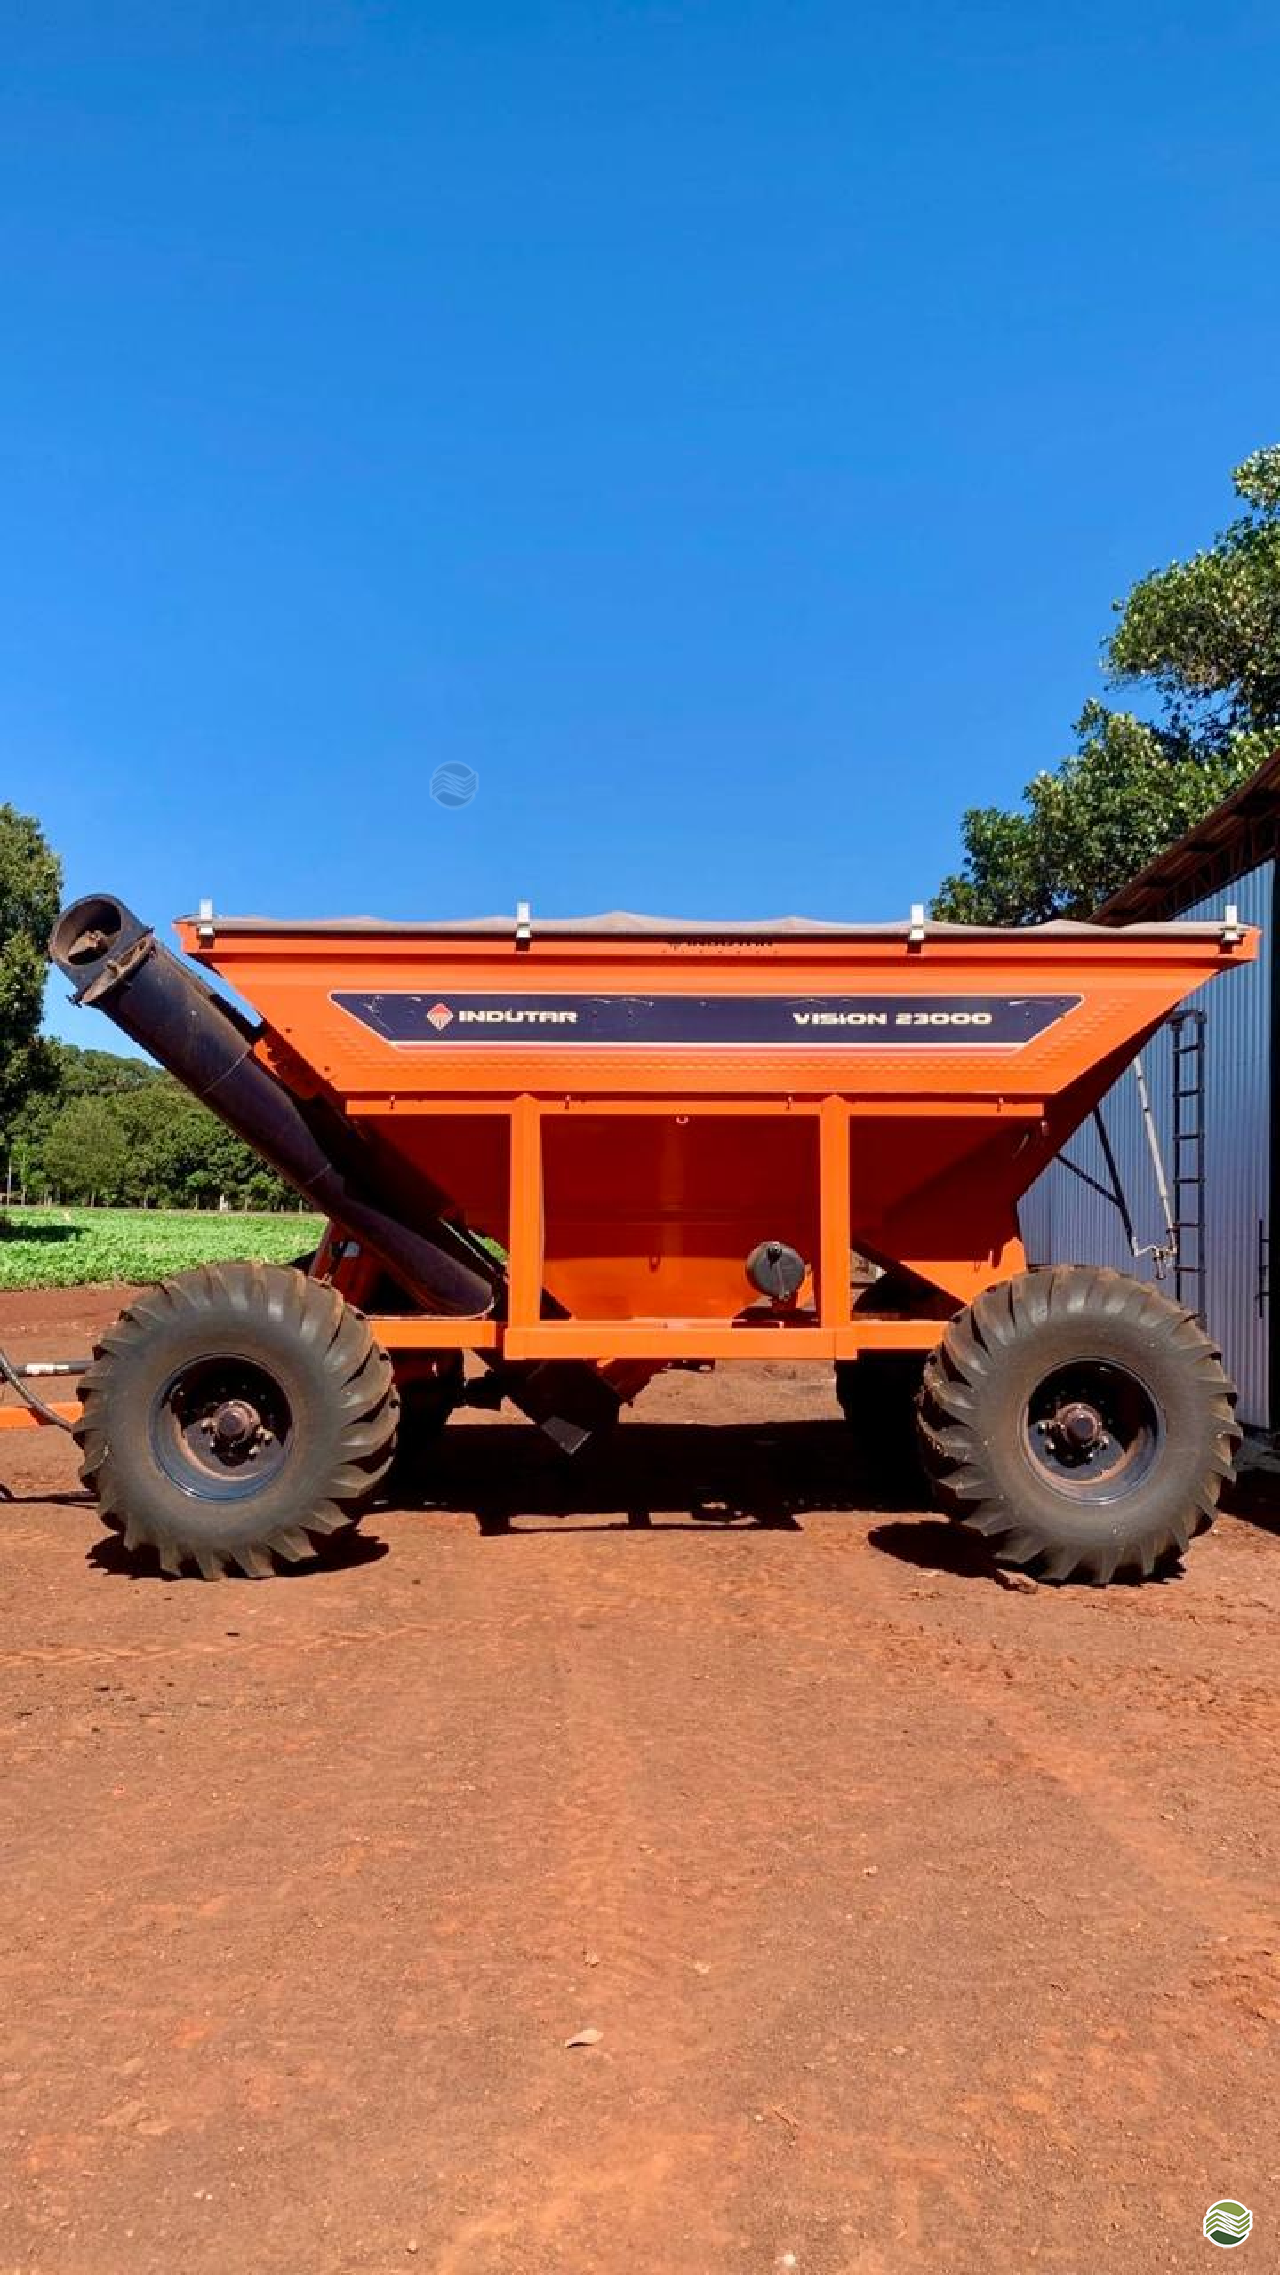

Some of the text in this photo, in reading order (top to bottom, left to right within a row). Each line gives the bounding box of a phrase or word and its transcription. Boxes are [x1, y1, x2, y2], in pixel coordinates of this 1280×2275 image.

[458, 1010, 578, 1023] INDUTAR
[793, 1012, 993, 1025] VISION 23000
